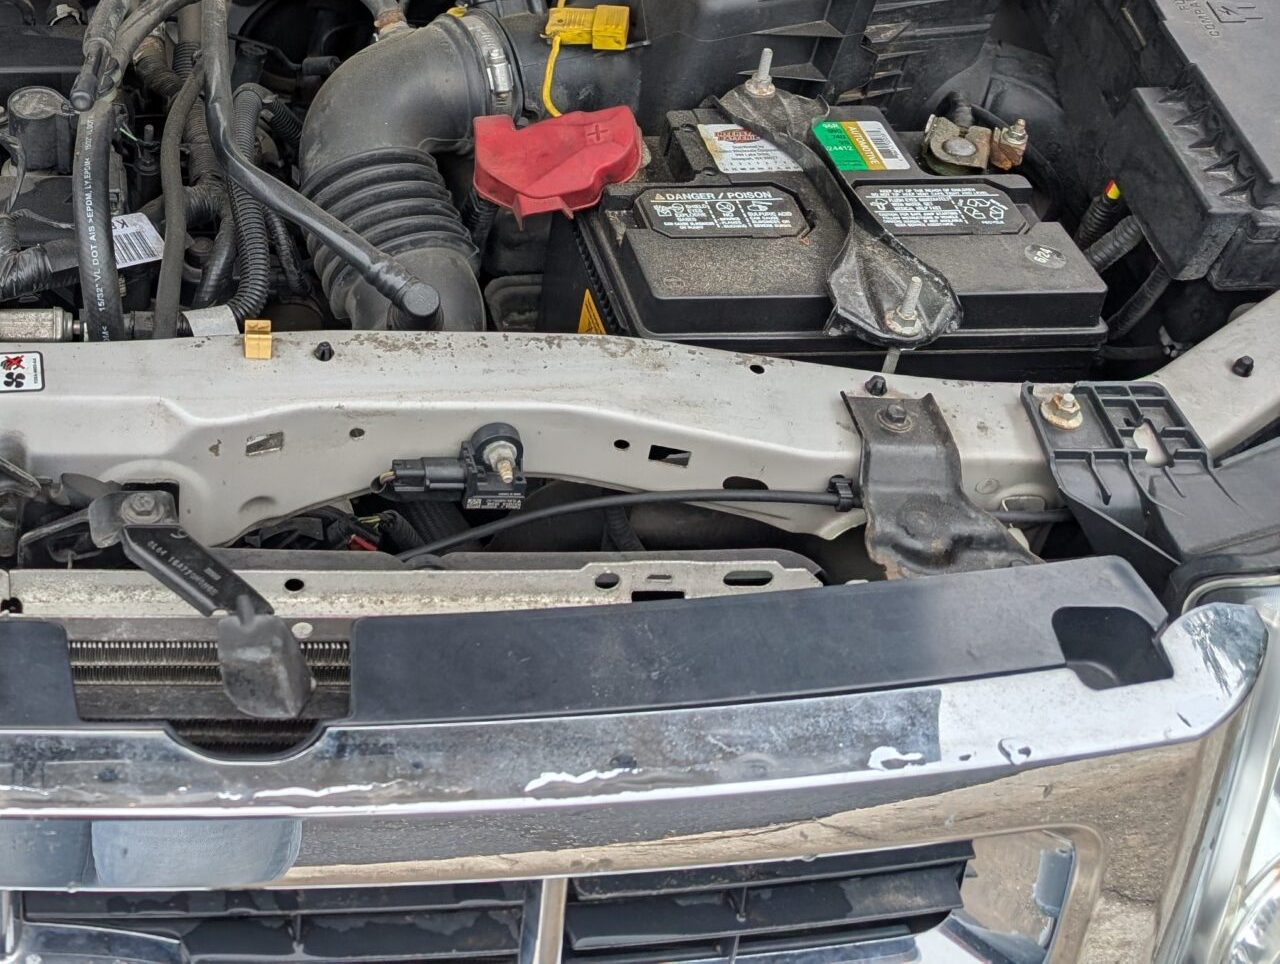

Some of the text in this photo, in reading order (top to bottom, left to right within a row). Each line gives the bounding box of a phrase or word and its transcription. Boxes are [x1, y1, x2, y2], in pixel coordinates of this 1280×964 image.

[848, 126, 880, 165] AUTOMOTIVE
[666, 193, 715, 201] DANGER
[727, 191, 772, 199] POISON
[91, 243, 99, 266] DOT
[1033, 247, 1053, 263] 6/24
[94, 268, 102, 282] VL
